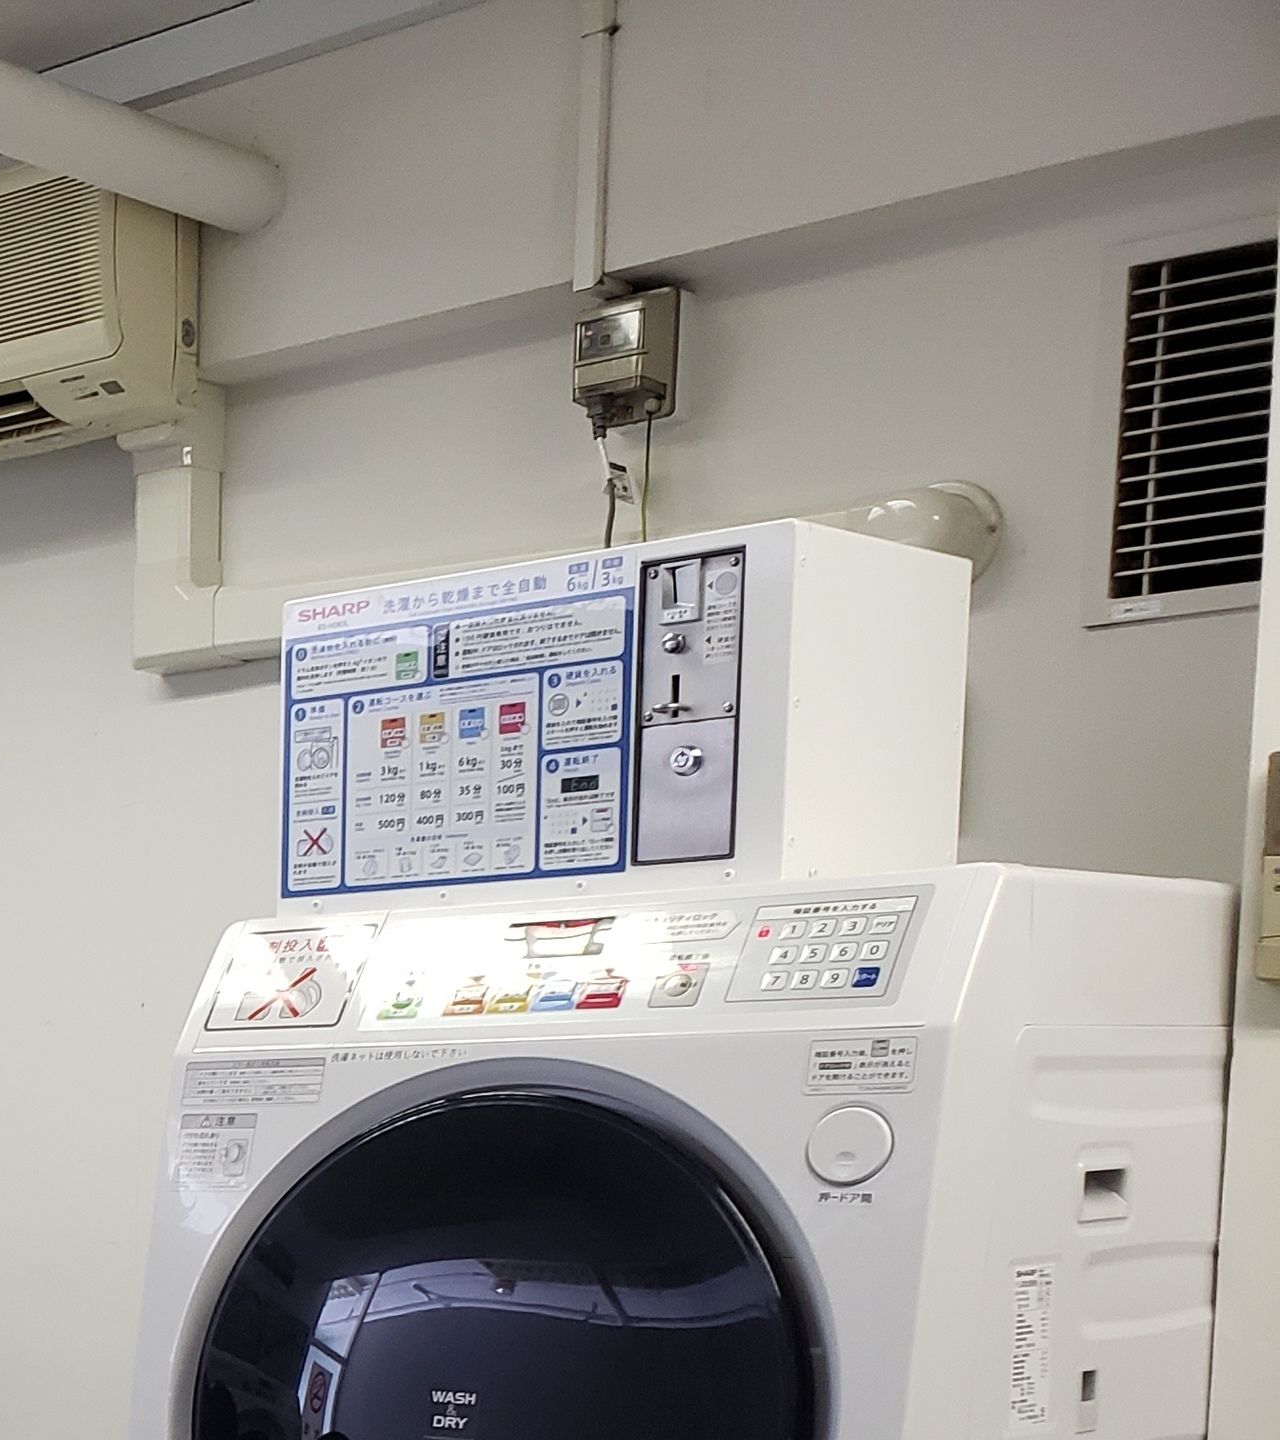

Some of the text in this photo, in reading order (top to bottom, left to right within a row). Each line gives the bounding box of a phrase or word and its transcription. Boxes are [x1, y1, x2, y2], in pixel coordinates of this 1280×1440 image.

[298, 600, 370, 622] SHARP
[791, 925, 797, 934] 1
[818, 923, 828, 933] 2
[848, 921, 857, 931] 3
[780, 945, 879, 959] 4 5 6 0
[772, 973, 839, 985] 7 8 9
[431, 1390, 477, 1405] WASH
[446, 1404, 457, 1416] &
[432, 1415, 468, 1429] DRY
